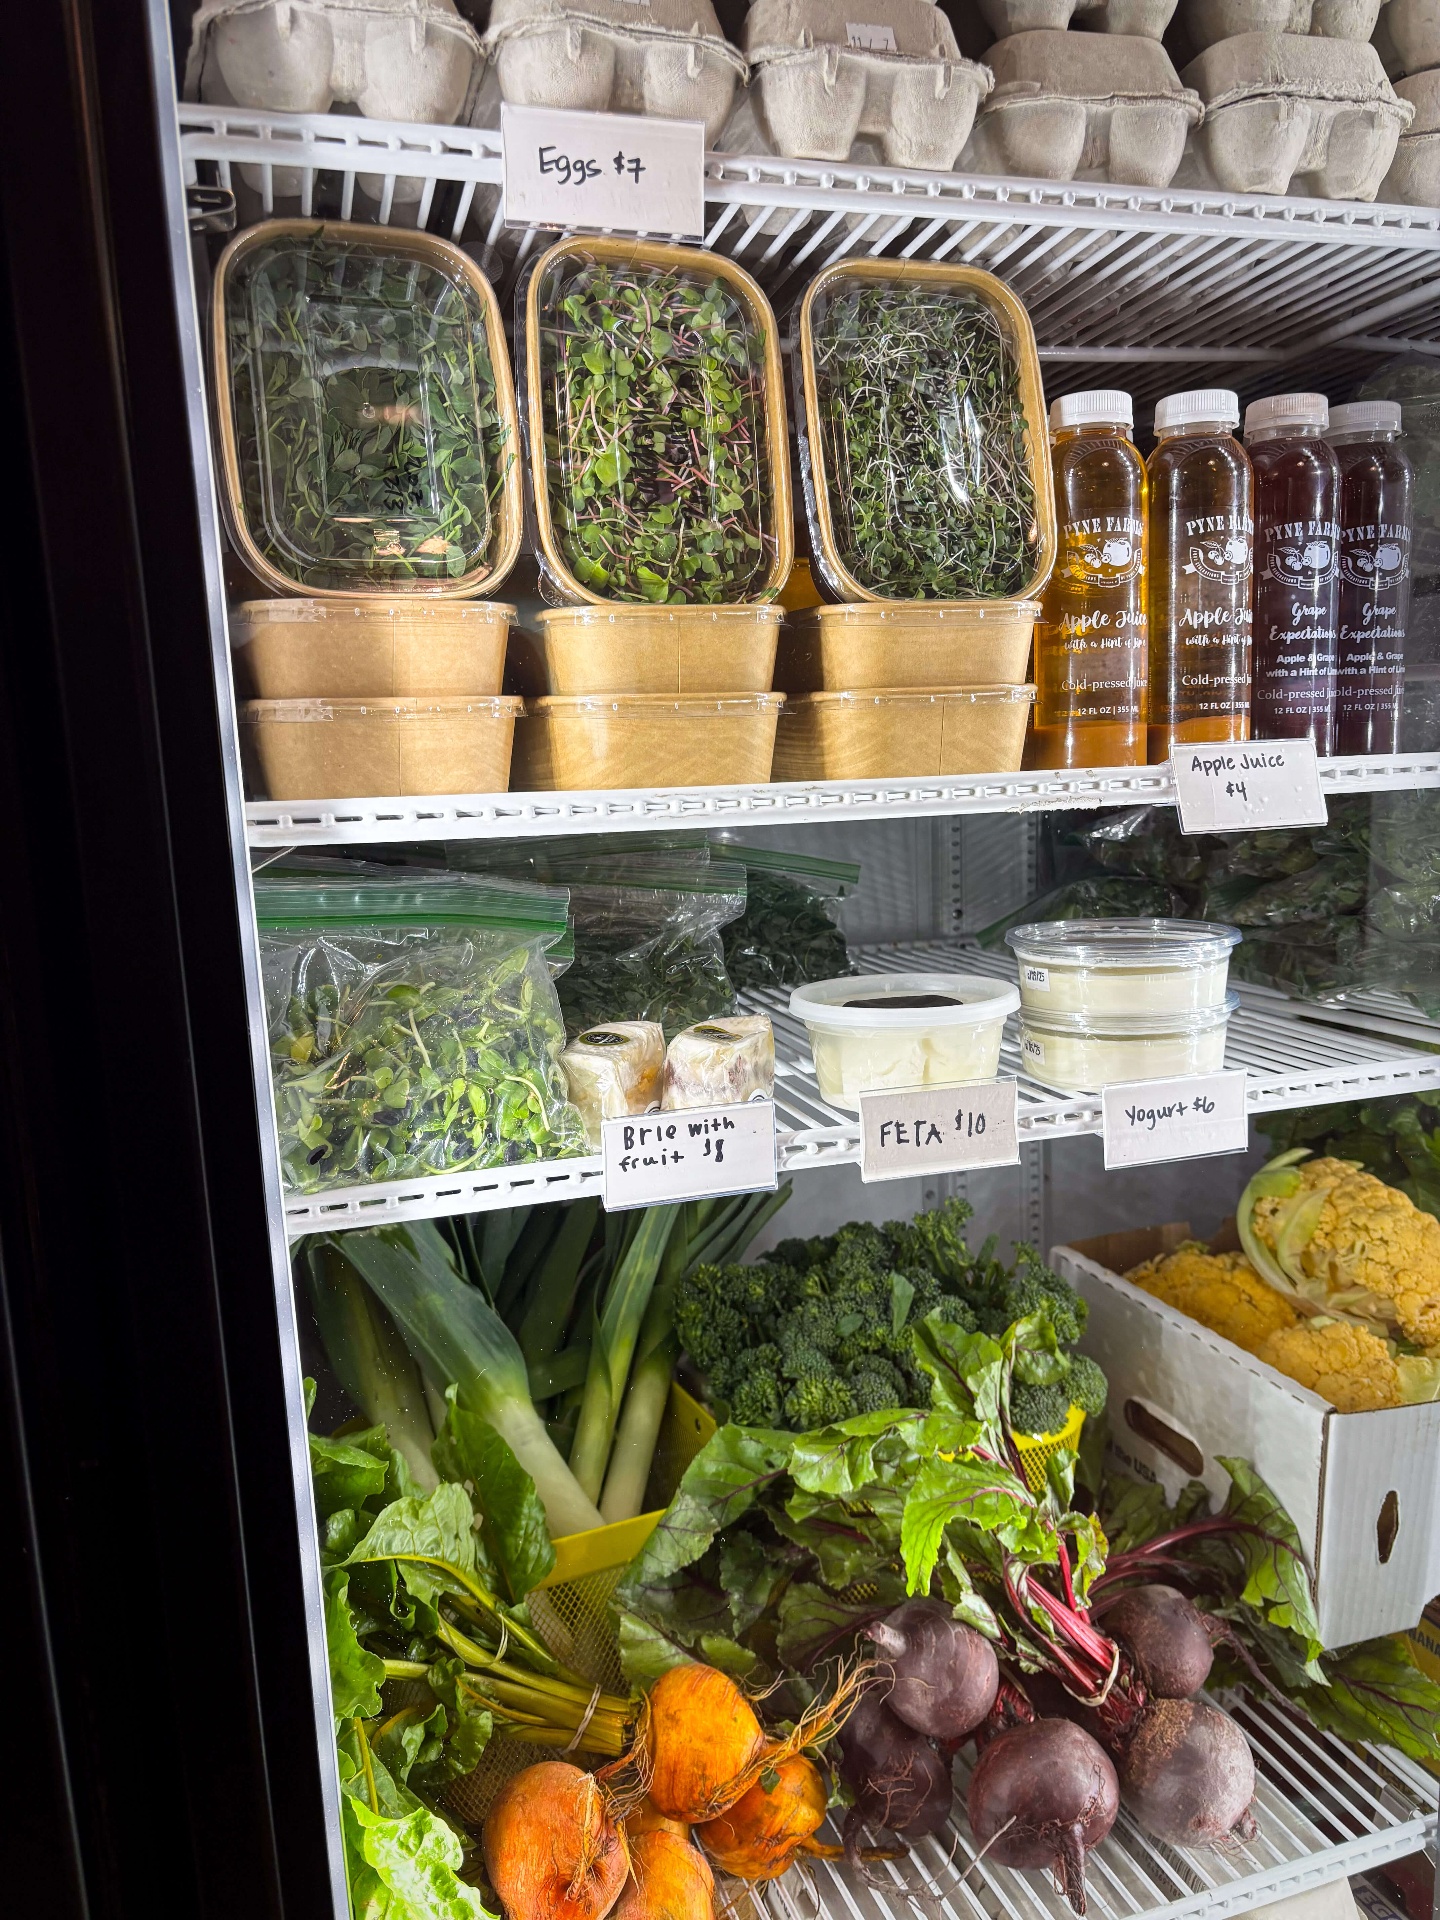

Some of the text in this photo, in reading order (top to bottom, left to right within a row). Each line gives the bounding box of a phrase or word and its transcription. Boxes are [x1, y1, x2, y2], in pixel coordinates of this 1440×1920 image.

[538, 146, 647, 186] Eggs $7
[1063, 517, 1102, 540] PYNE
[1186, 515, 1225, 536] PYNE
[1264, 521, 1304, 543] PYNE
[1379, 523, 1412, 543] FARMS
[1059, 610, 1148, 634] Apple Juice
[1179, 607, 1232, 630] Apple
[1291, 602, 1328, 627] Grape
[1362, 602, 1397, 626] Grape
[1065, 637, 1088, 651] with
[1090, 640, 1099, 648] a
[1185, 633, 1210, 647] with
[1212, 637, 1221, 645] a
[1221, 633, 1241, 646] Hint
[1269, 625, 1337, 645] Expectations
[1340, 624, 1406, 644] Expectations
[1276, 653, 1306, 665] Apple
[1376, 652, 1384, 660] &
[1265, 668, 1289, 678] with
[1289, 669, 1298, 677] a
[1299, 667, 1319, 677] Hint
[1319, 667, 1327, 676] of
[1337, 666, 1358, 675] with
[1359, 667, 1367, 675] a
[1368, 665, 1387, 675] Hint
[1387, 665, 1396, 674] of
[1061, 677, 1132, 692] Cold-pressed
[1181, 673, 1246, 688] Cold-pressed
[1257, 687, 1325, 701] Cold-pressed
[1336, 684, 1393, 699] old-pressed
[1088, 706, 1098, 715] FL
[1099, 706, 1112, 714] OZ
[1117, 705, 1130, 714] 355
[1198, 702, 1209, 711] 12
[1210, 702, 1219, 710] FL
[1220, 701, 1231, 710] OZ
[1234, 701, 1244, 709] 355
[1274, 707, 1283, 715] 12
[1285, 706, 1295, 714] FL
[1296, 706, 1308, 714] OZ
[1312, 705, 1324, 713] 355
[1354, 703, 1363, 711] FL
[1380, 702, 1391, 710] 355
[1191, 753, 1285, 777] Apple Juice
[1225, 781, 1248, 801] $4
[1125, 1096, 1216, 1130] Yogurt $6
[688, 1117, 735, 1138] with
[880, 1109, 987, 1148] FETA $10
[618, 1148, 685, 1172] fruit
